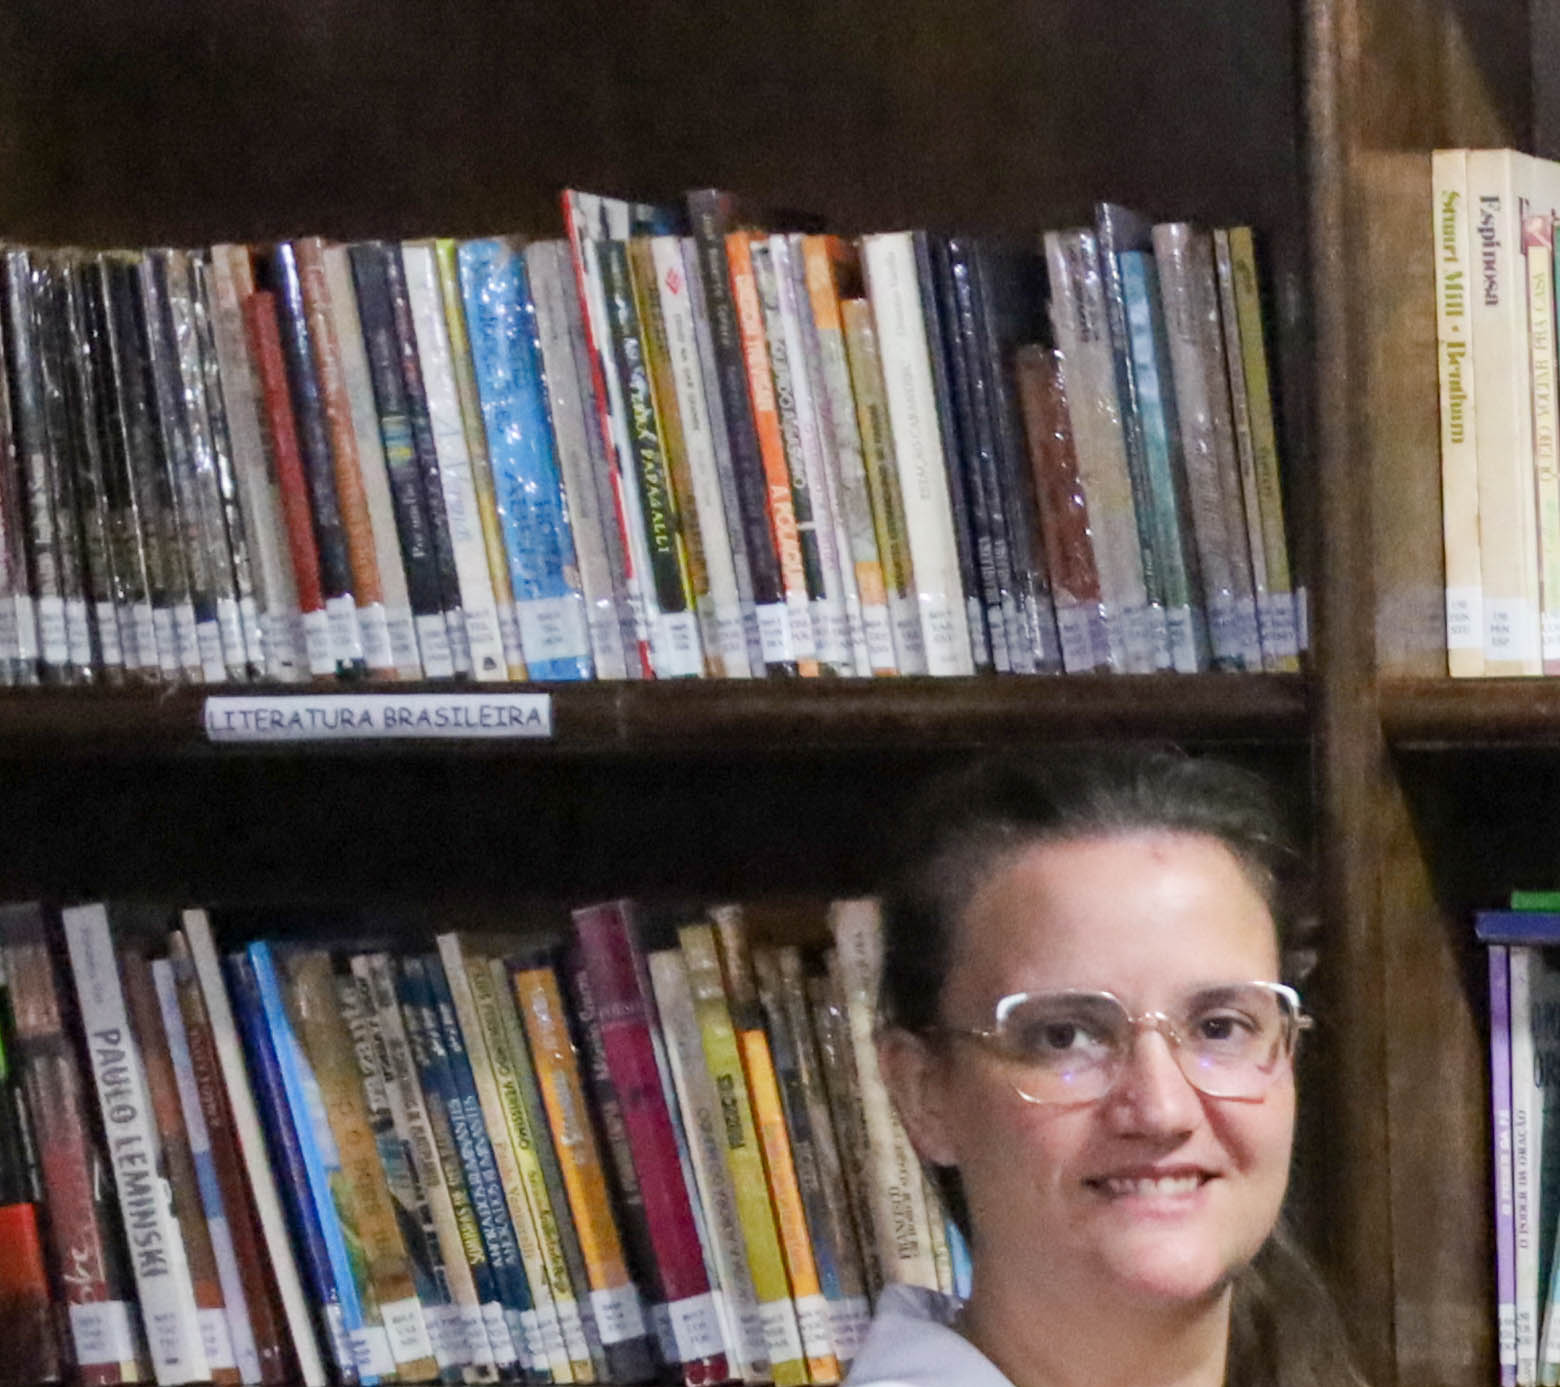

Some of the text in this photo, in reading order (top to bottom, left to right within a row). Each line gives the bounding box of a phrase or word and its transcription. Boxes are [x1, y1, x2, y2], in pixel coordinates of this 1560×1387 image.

[1476, 194, 1501, 306] Espinosa
[1443, 270, 1463, 316] Mill
[208, 706, 544, 733] LITERATURA BRASILEIRA
[91, 1025, 172, 1279] PAULO LEMINSKI
